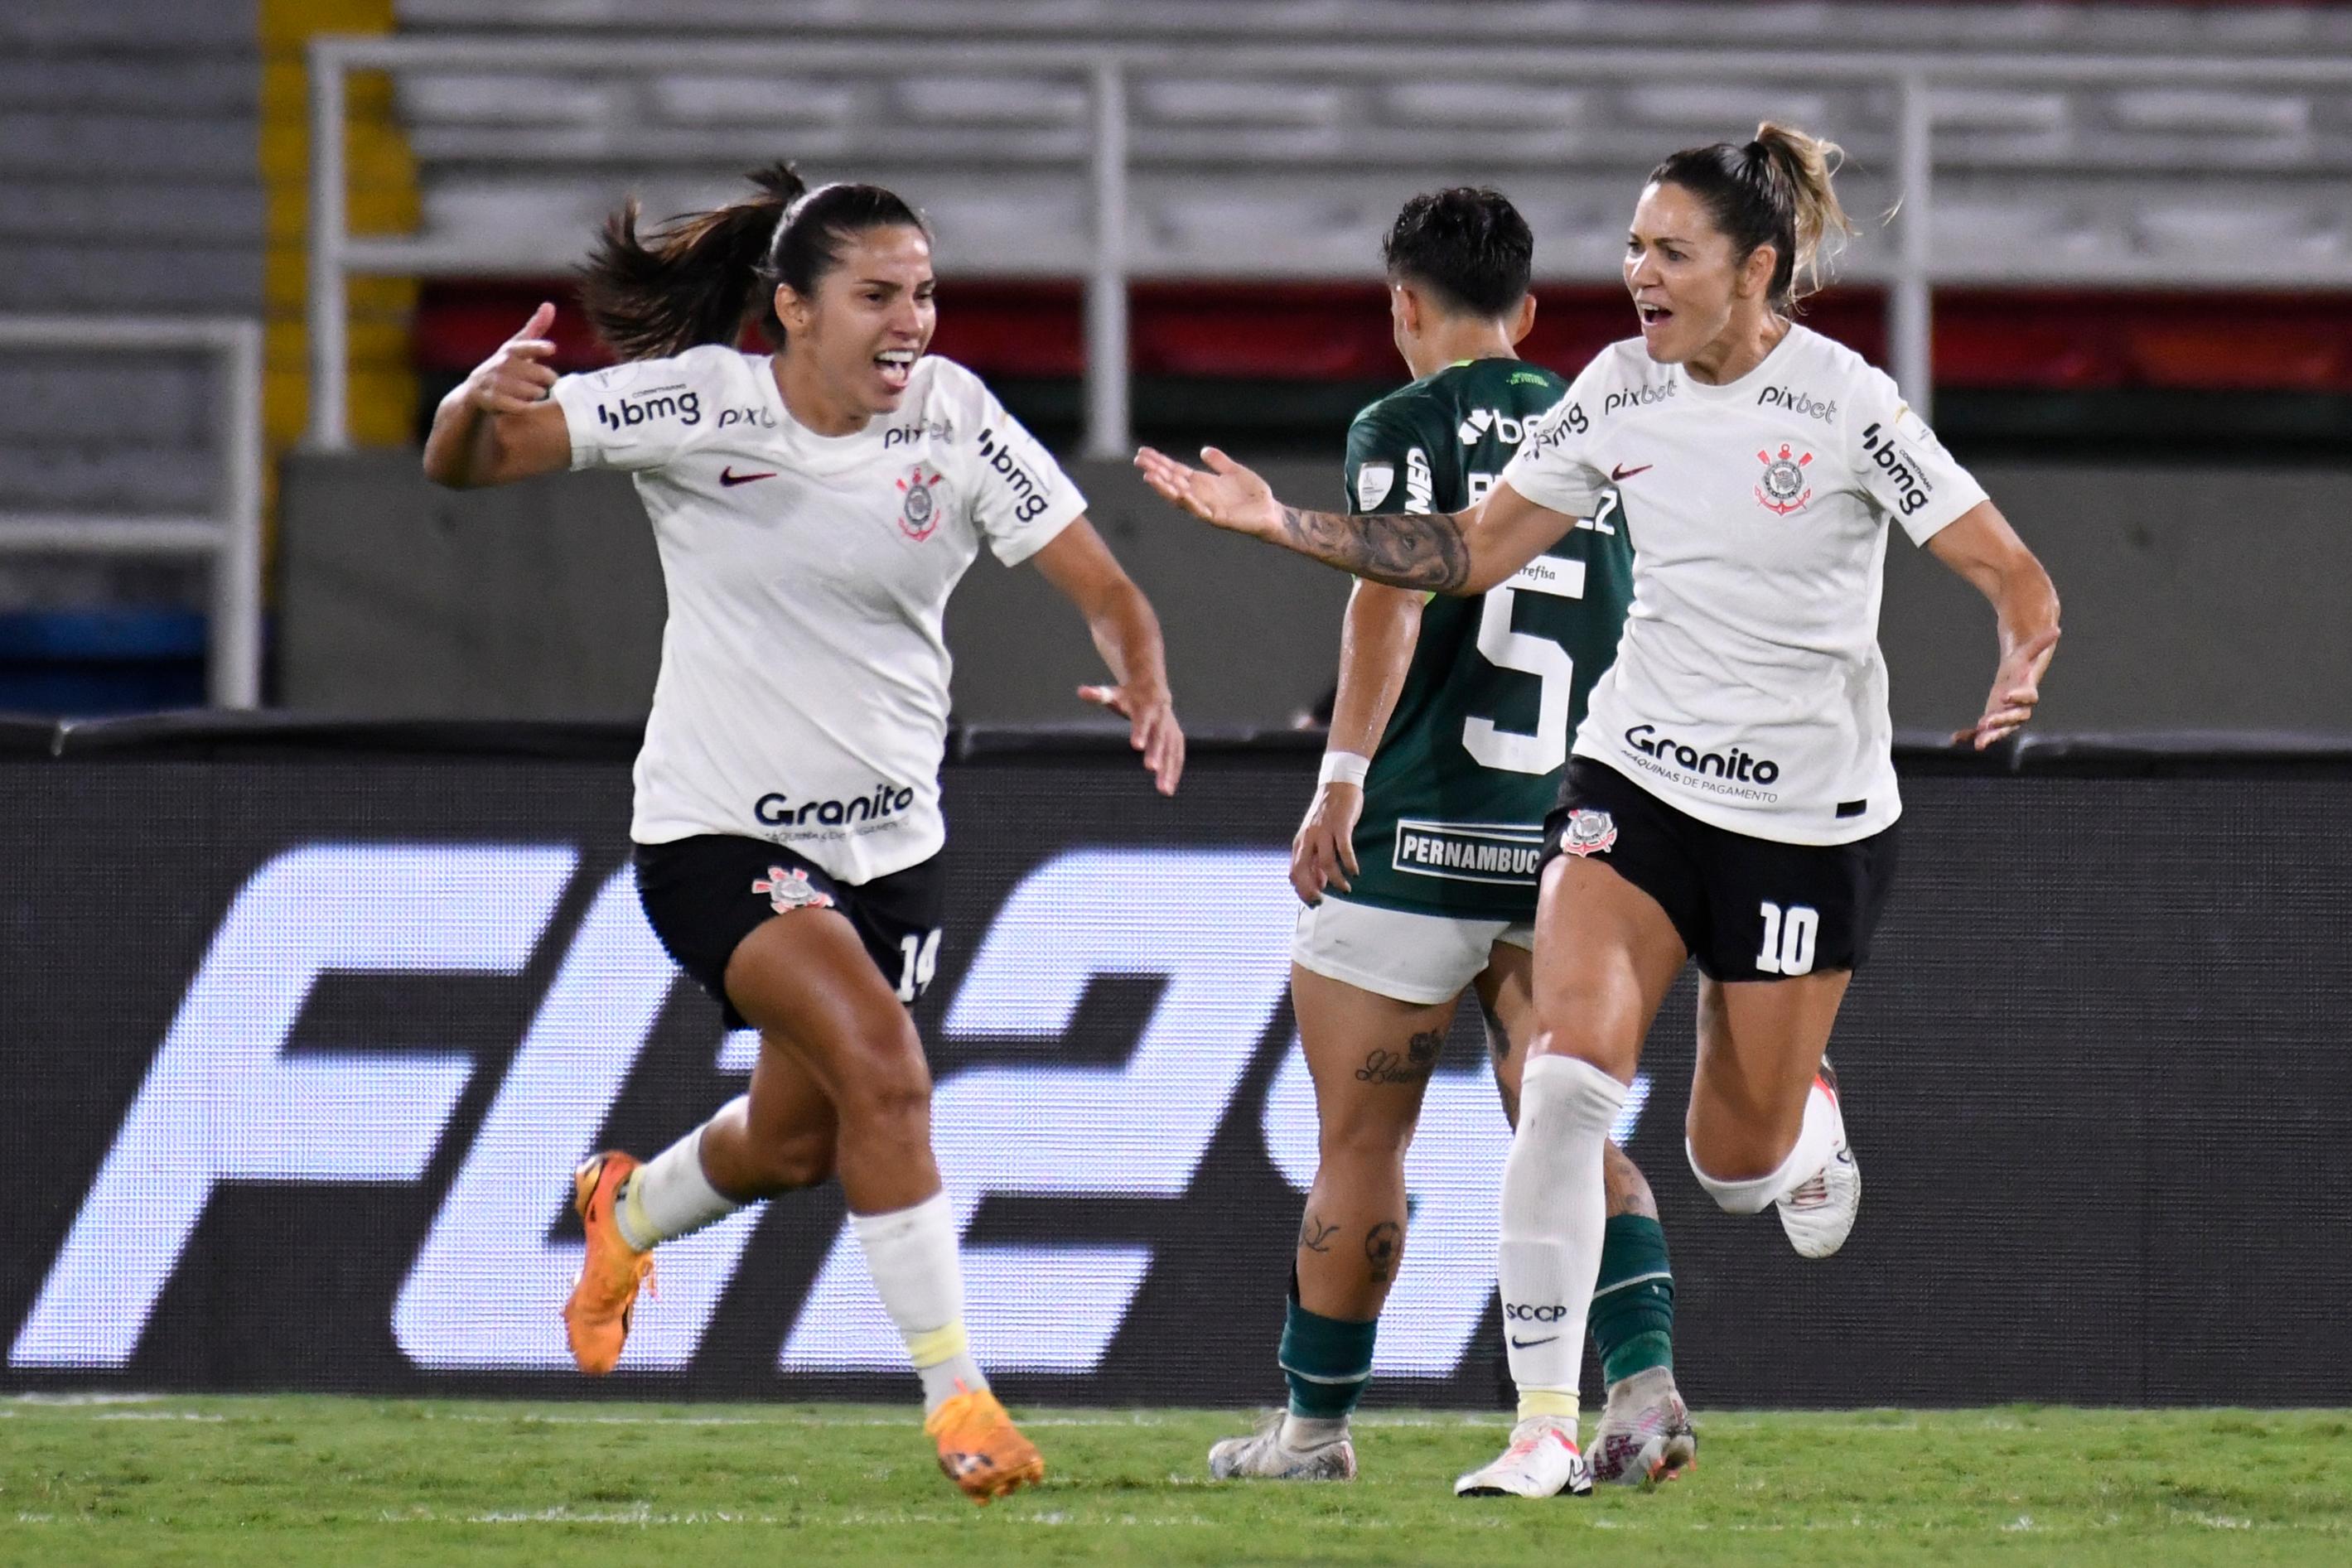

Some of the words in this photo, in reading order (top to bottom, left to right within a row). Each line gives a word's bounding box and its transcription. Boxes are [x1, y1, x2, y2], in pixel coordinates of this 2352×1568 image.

[620, 392, 701, 427] bmg
[717, 405, 778, 429] pixb
[1605, 379, 1678, 416] pixbet
[1756, 385, 1838, 425] pixbet
[990, 444, 1049, 523] bmg
[1404, 447, 1432, 515] MED
[1871, 439, 1929, 517] bmg
[1517, 564, 1557, 581] refisa
[1461, 554, 1587, 776] 5
[1625, 724, 1780, 785] Granito
[754, 784, 914, 827] Granito
[1682, 775, 1699, 789] DE
[1701, 780, 1779, 804] PAGAMENTO
[1402, 834, 1542, 876] PERNAMBUC
[1755, 900, 1820, 977] 10
[896, 928, 943, 1002] 14
[1505, 1302, 1567, 1323] SCCP
